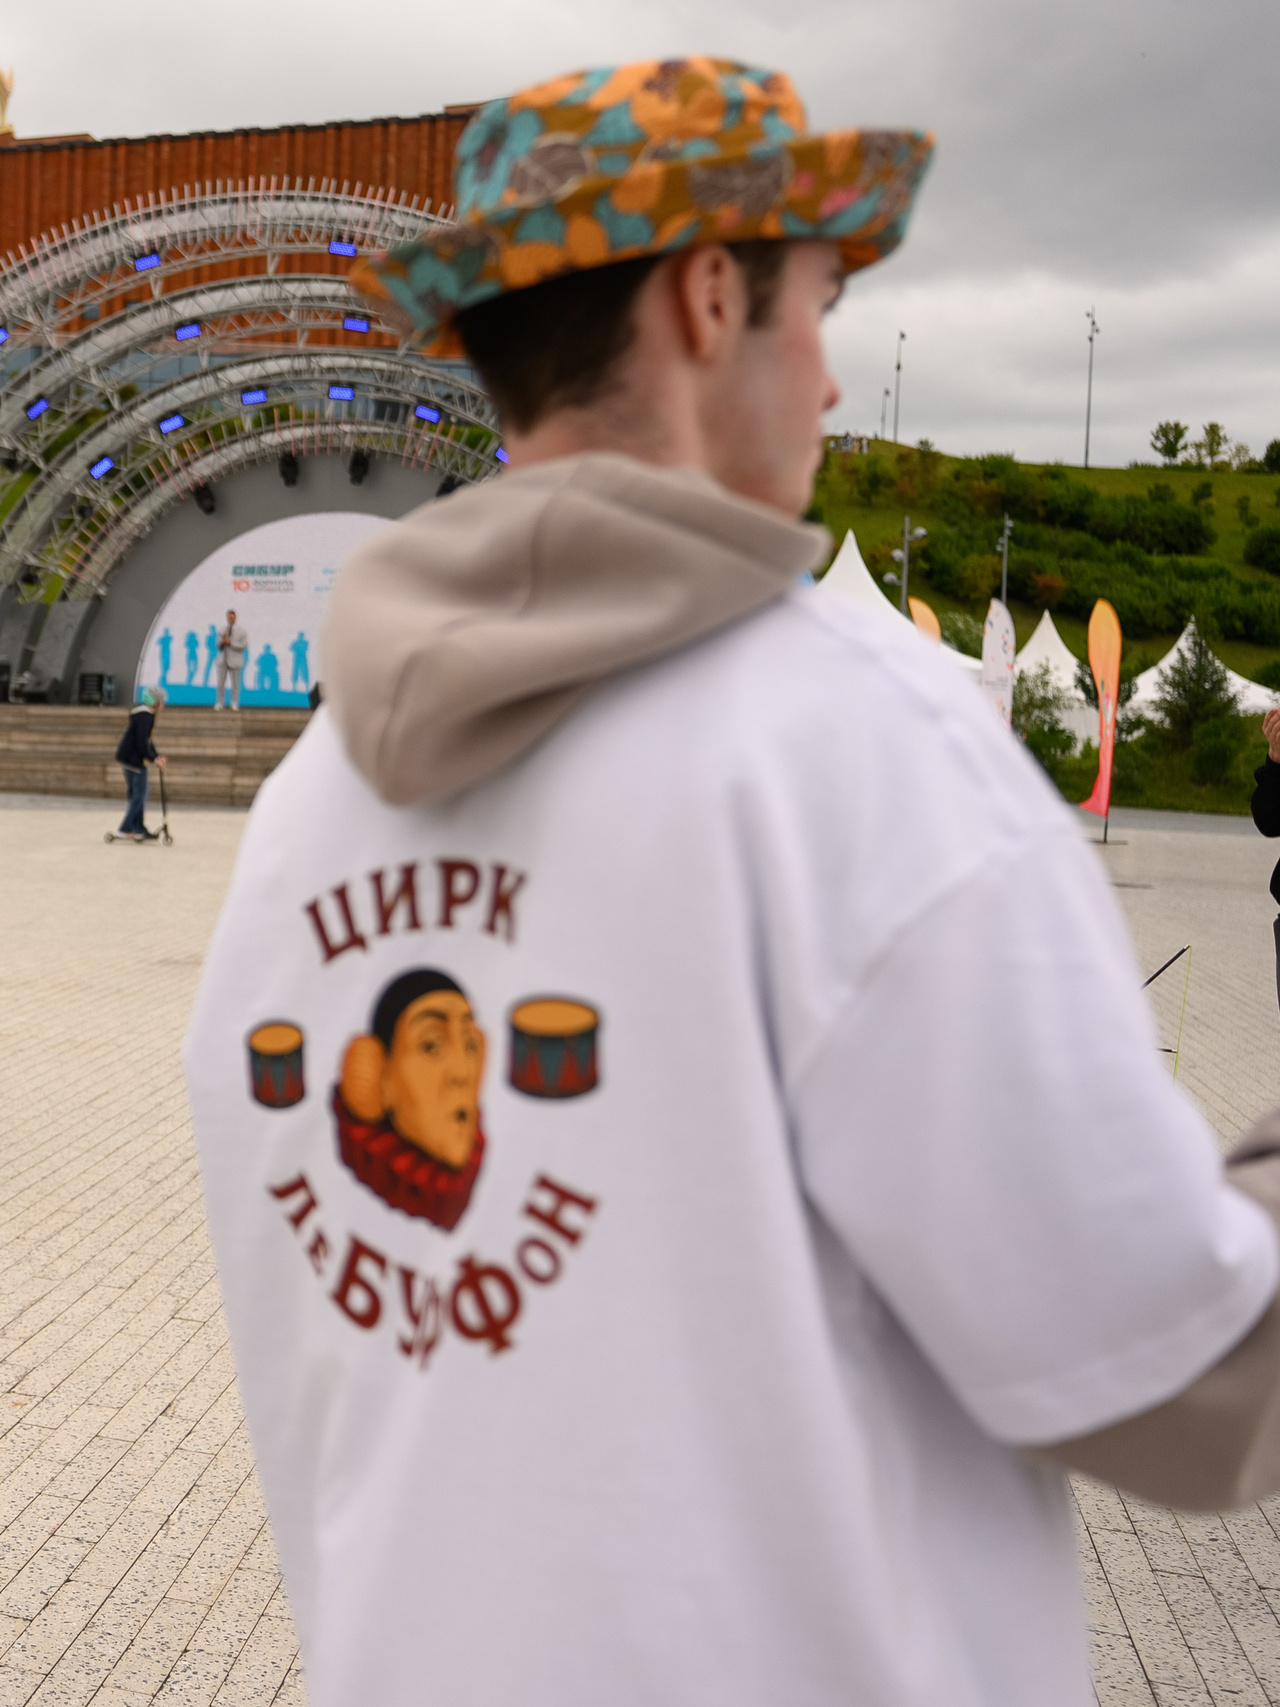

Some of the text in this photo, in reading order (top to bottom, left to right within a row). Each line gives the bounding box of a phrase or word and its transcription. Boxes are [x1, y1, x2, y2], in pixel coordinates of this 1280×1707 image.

[232, 565, 294, 576] СИБУР
[232, 579, 251, 592] 10
[304, 858, 525, 963] ЦИРК
